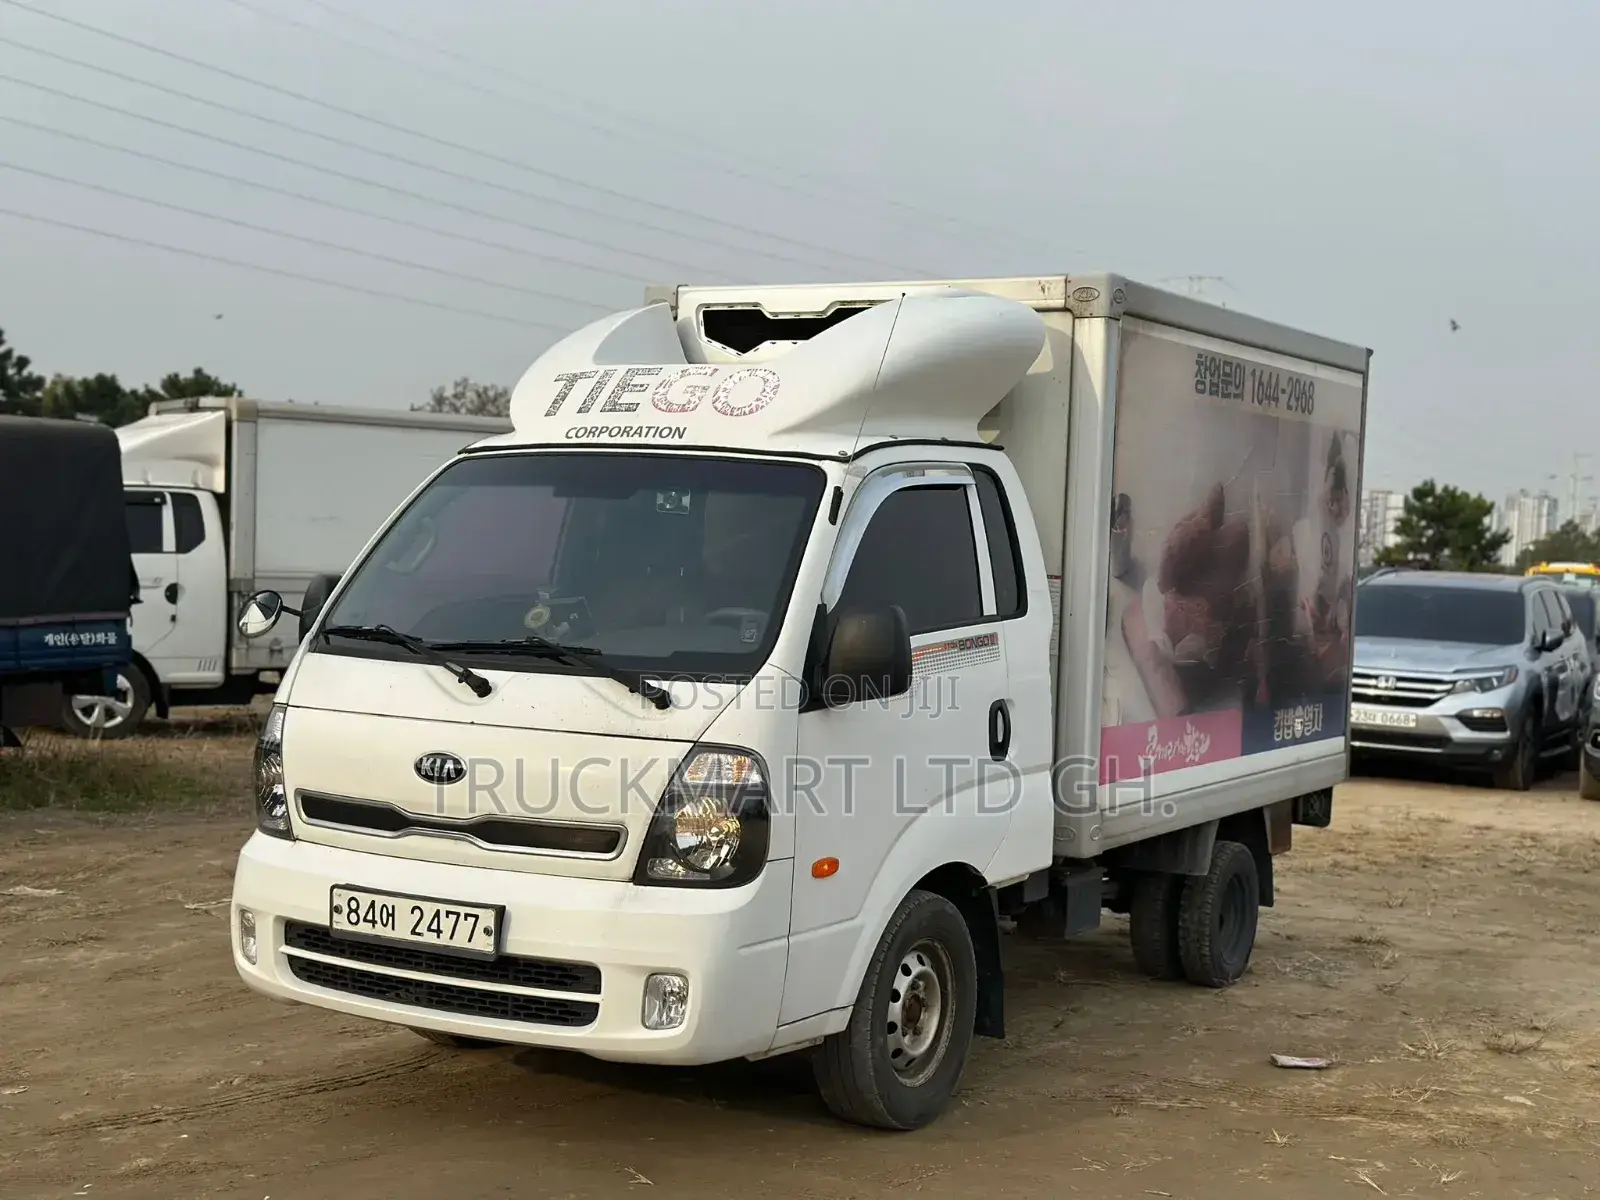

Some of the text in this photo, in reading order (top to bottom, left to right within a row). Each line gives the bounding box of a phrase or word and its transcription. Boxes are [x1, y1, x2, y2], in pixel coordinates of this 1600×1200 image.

[544, 366, 780, 417] TIEGO
[1194, 353, 1315, 415] 창업문의 1644-2968
[564, 426, 687, 439] CORPORATION
[1380, 712, 1411, 726] 0668
[420, 756, 456, 778] KIA
[346, 896, 480, 943] 84어 2477
